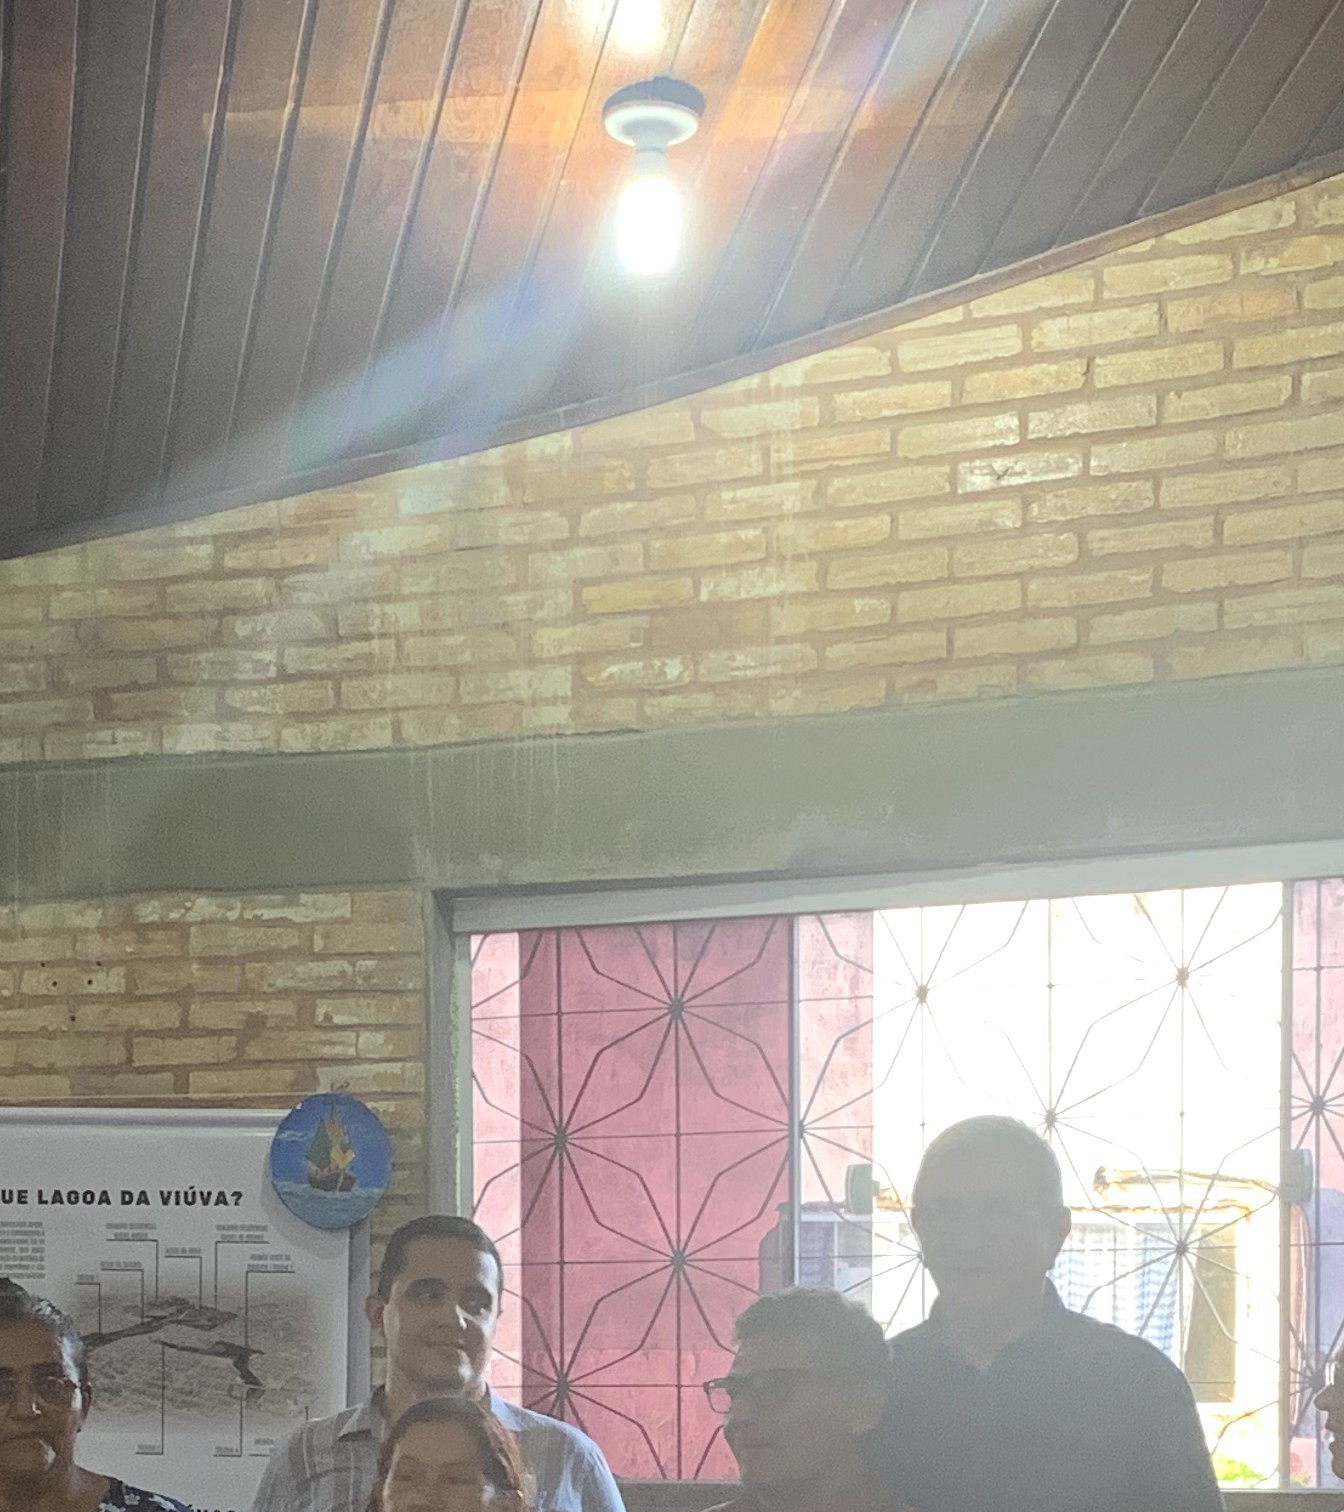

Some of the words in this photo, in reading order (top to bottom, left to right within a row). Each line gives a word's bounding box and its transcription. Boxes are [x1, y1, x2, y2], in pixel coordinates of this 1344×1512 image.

[37, 1189, 112, 1206] LAGOA
[120, 1190, 150, 1206] DA
[159, 1185, 244, 1207] VIÚVA?
